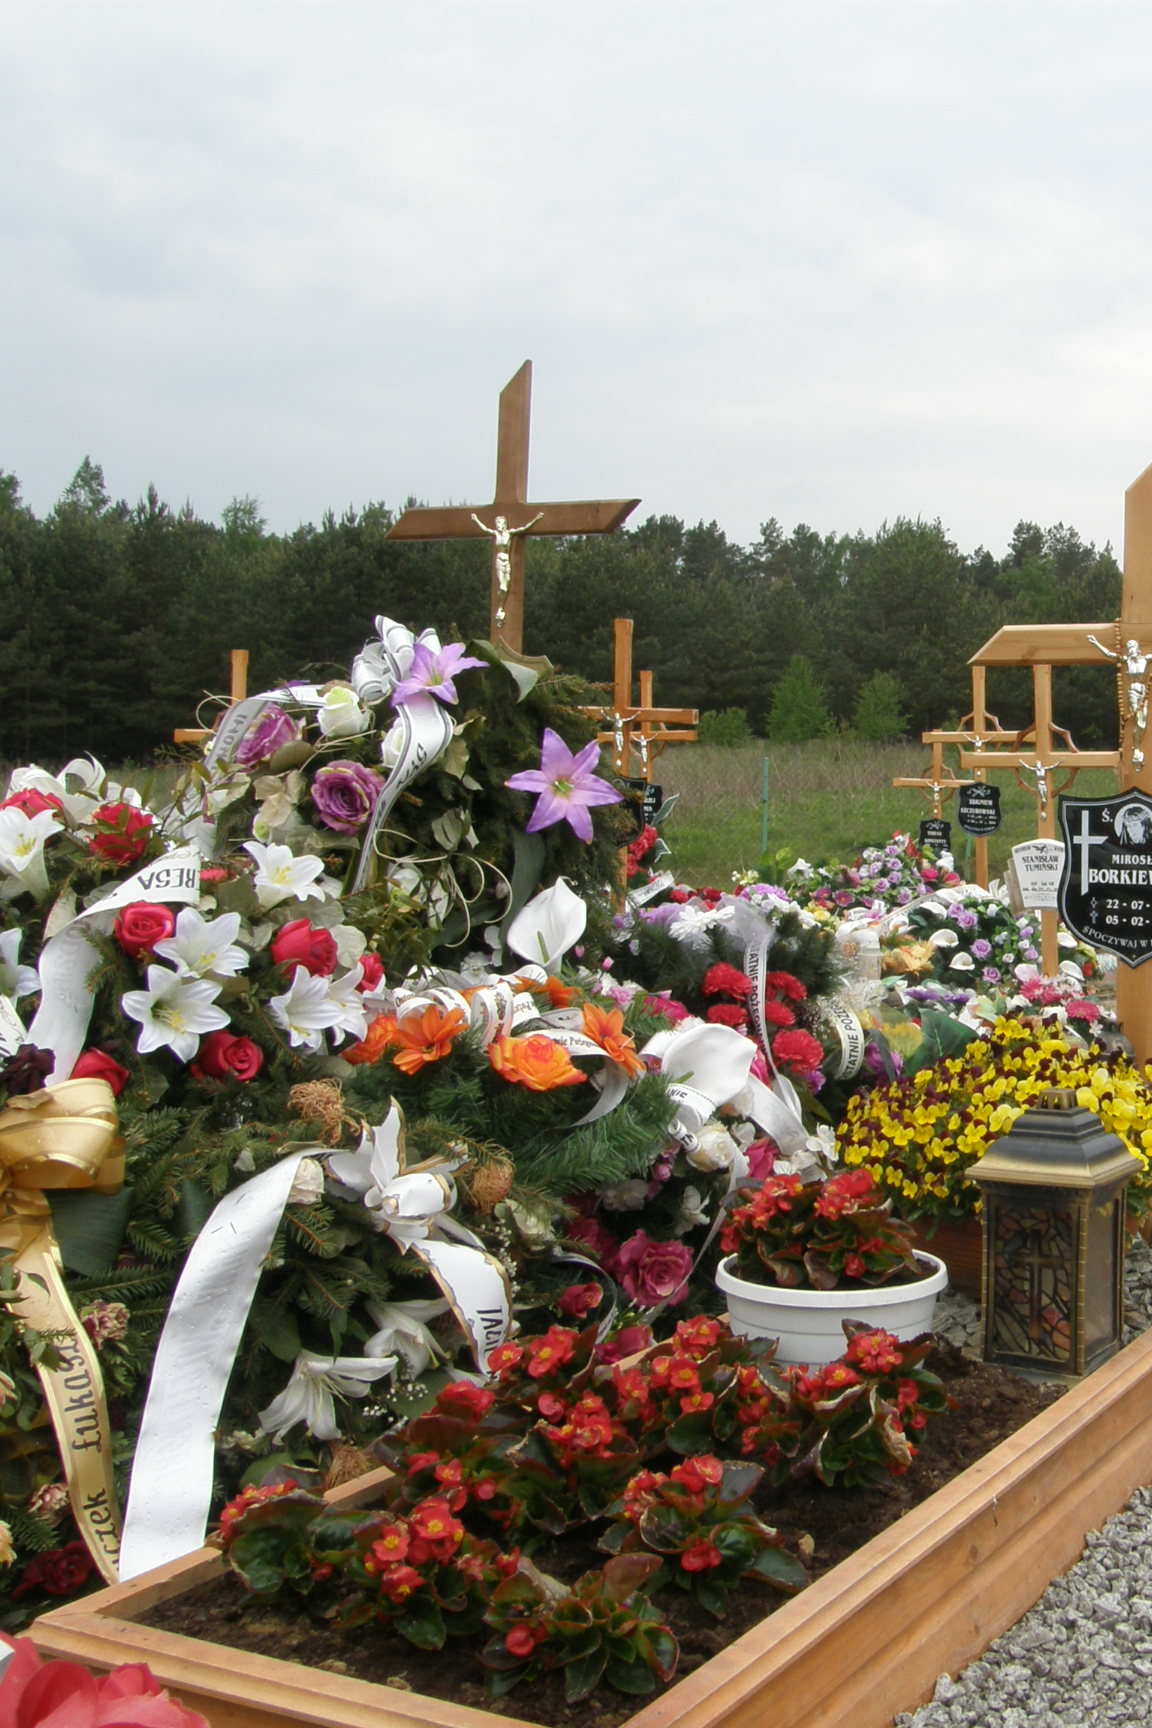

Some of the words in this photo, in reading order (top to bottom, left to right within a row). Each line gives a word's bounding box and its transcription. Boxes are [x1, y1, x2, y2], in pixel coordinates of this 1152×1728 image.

[137, 868, 199, 890] RESA
[1106, 898, 1119, 909] 22
[1130, 900, 1144, 910] 07
[1105, 914, 1119, 925] 05
[1130, 916, 1144, 927] 02
[1082, 925, 1137, 949] SPOCZYWAJ
[1139, 940, 1148, 948] W
